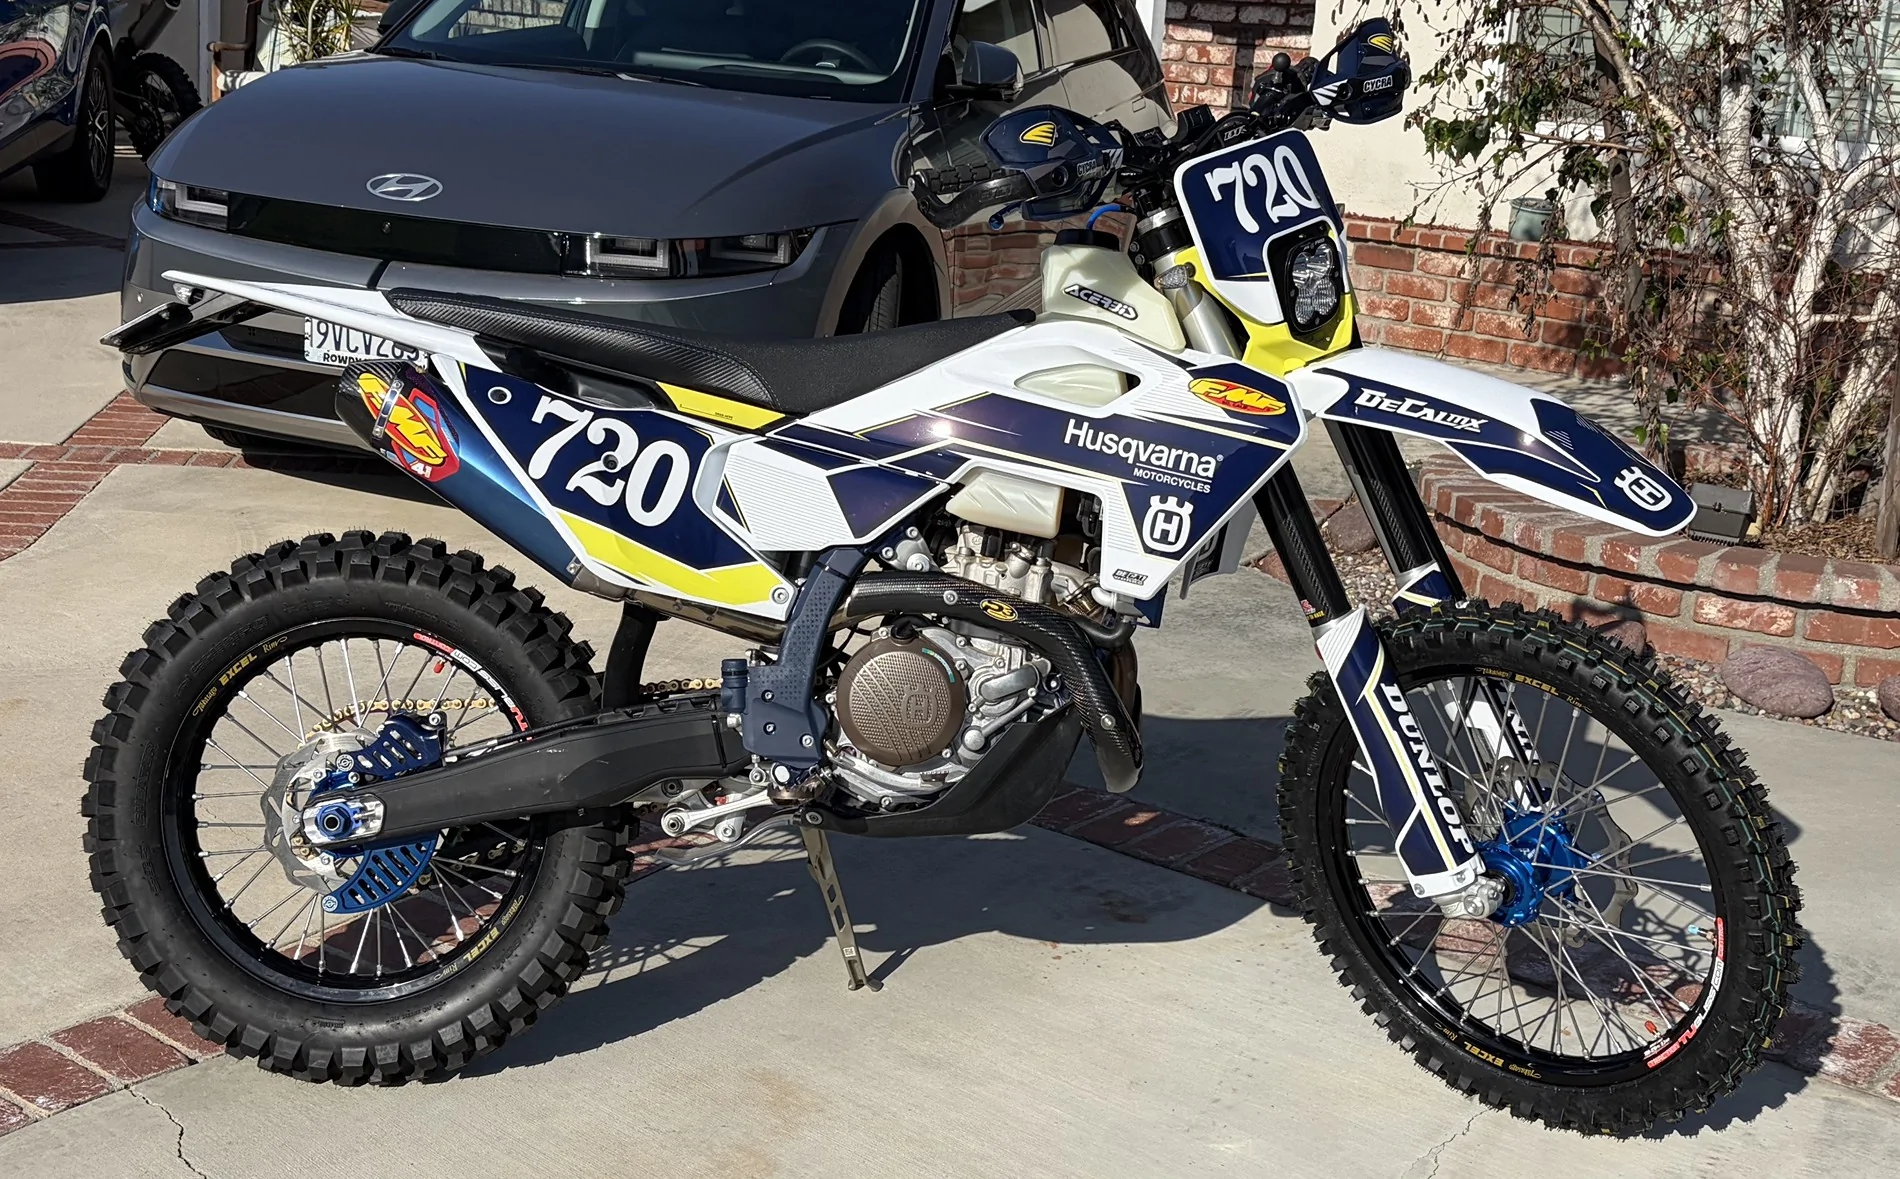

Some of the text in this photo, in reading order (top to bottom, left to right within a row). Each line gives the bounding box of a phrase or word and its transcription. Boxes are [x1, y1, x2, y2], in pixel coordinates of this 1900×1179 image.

[1362, 75, 1393, 93] CYCRA
[1204, 145, 1322, 234] 720
[1189, 380, 1286, 411] FMF
[528, 395, 690, 527] 720
[1064, 419, 1217, 478] Husqvarna
[1133, 467, 1211, 493] MOTORCYCLES
[219, 652, 258, 686] EXCEL
[1514, 673, 1559, 696] EXCEL
[1380, 683, 1475, 854] DUNLOP
[463, 926, 500, 962] EXCEL
[1463, 1041, 1505, 1067] EXCEL
